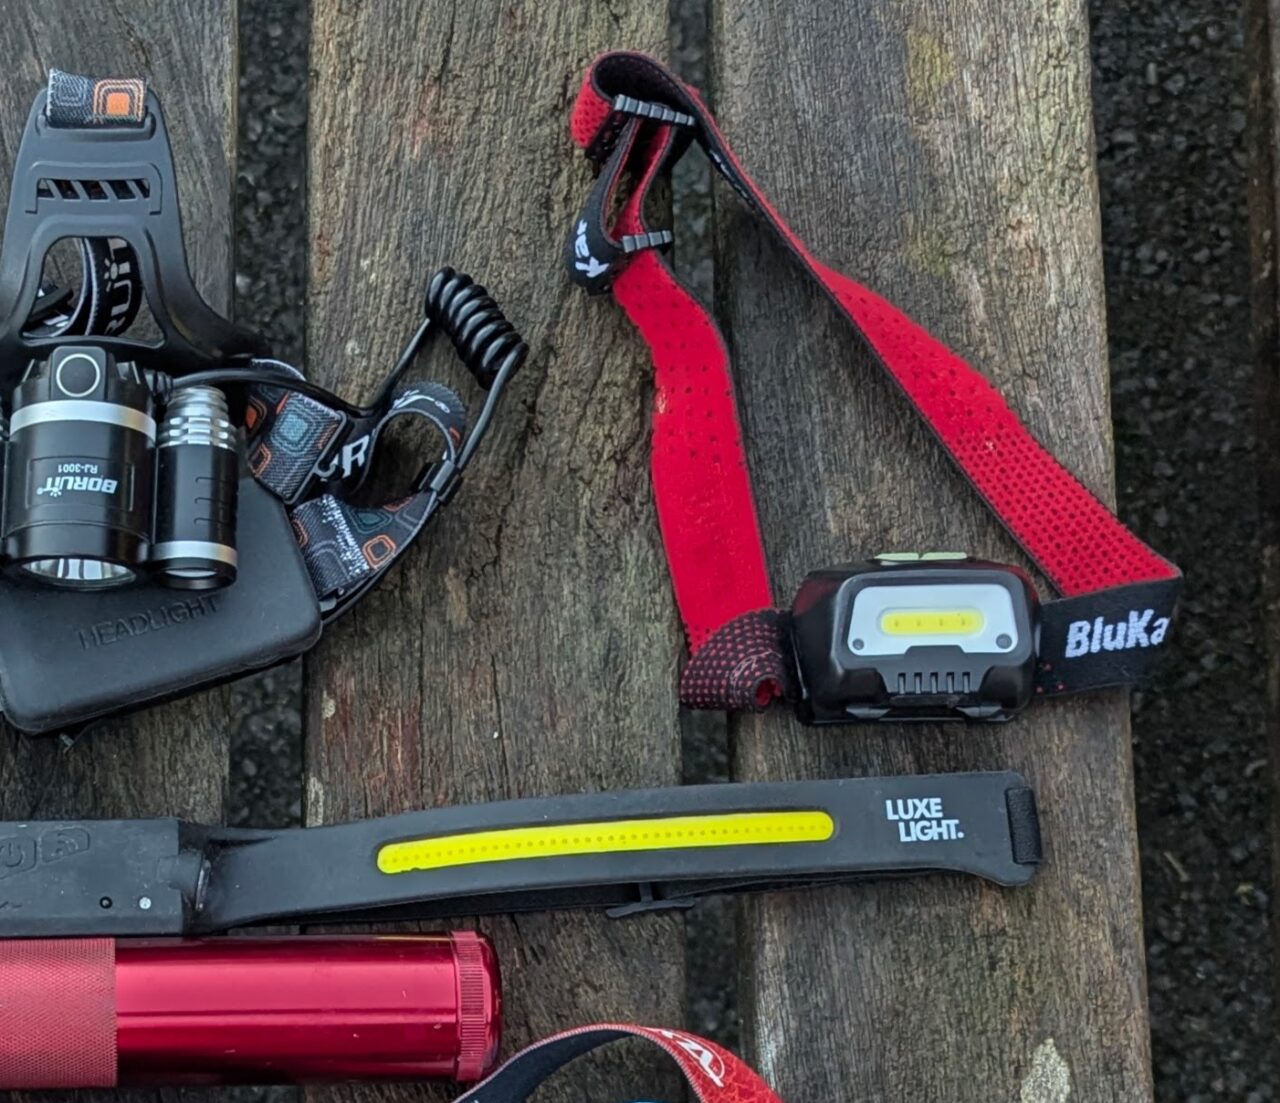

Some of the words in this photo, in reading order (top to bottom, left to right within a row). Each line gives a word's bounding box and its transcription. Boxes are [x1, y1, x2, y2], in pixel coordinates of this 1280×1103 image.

[58, 463, 98, 474] RJ-3001
[77, 591, 220, 650] HEADLIGHT
[885, 797, 944, 820] LUXE
[898, 819, 965, 842] LIGHT.
